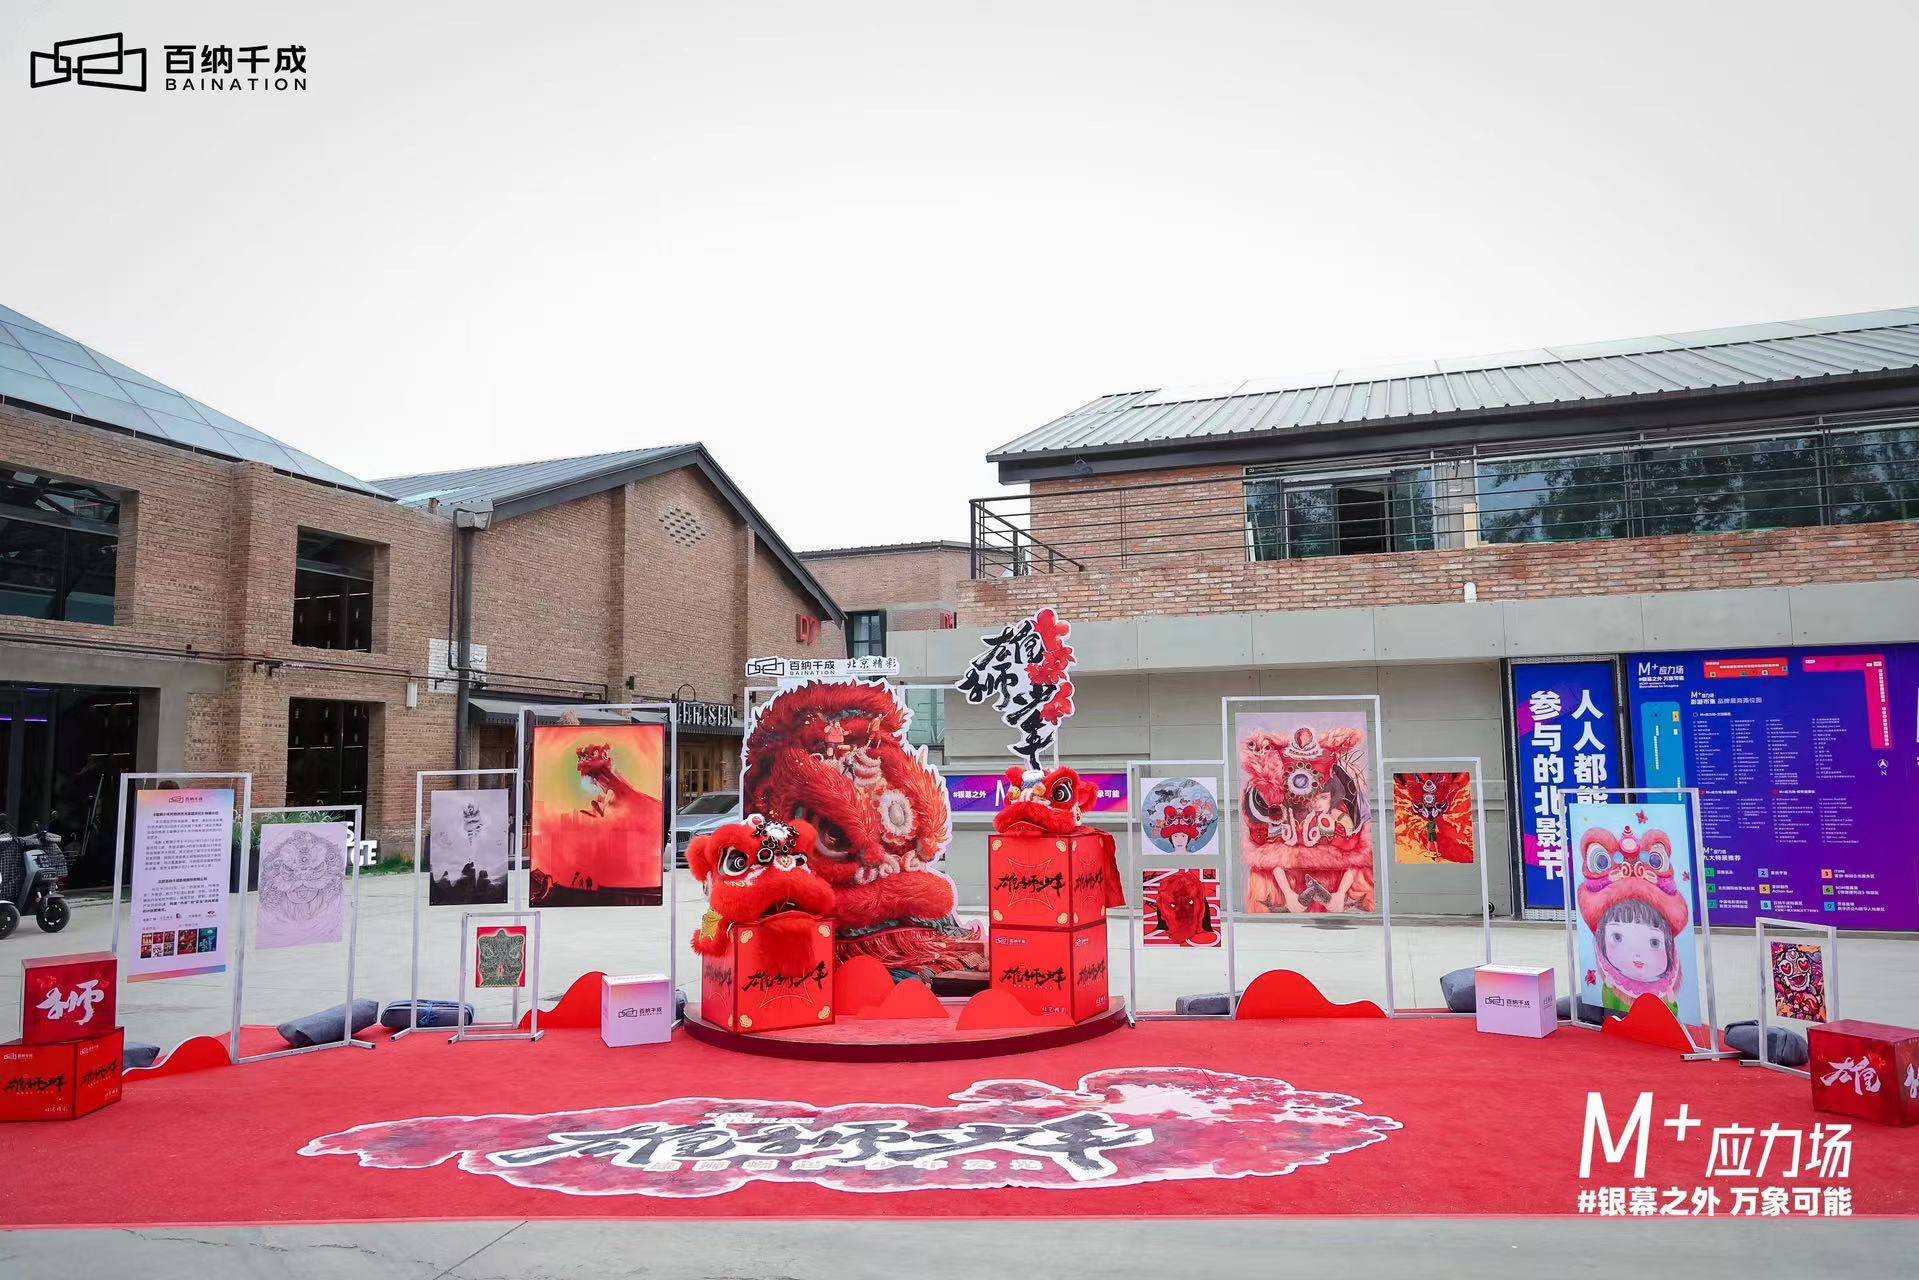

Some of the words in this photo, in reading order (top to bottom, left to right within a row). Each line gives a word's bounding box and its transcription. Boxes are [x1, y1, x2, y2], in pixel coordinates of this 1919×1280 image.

[789, 660, 836, 670] 百纳千成
[847, 657, 897, 669] 北京精彩
